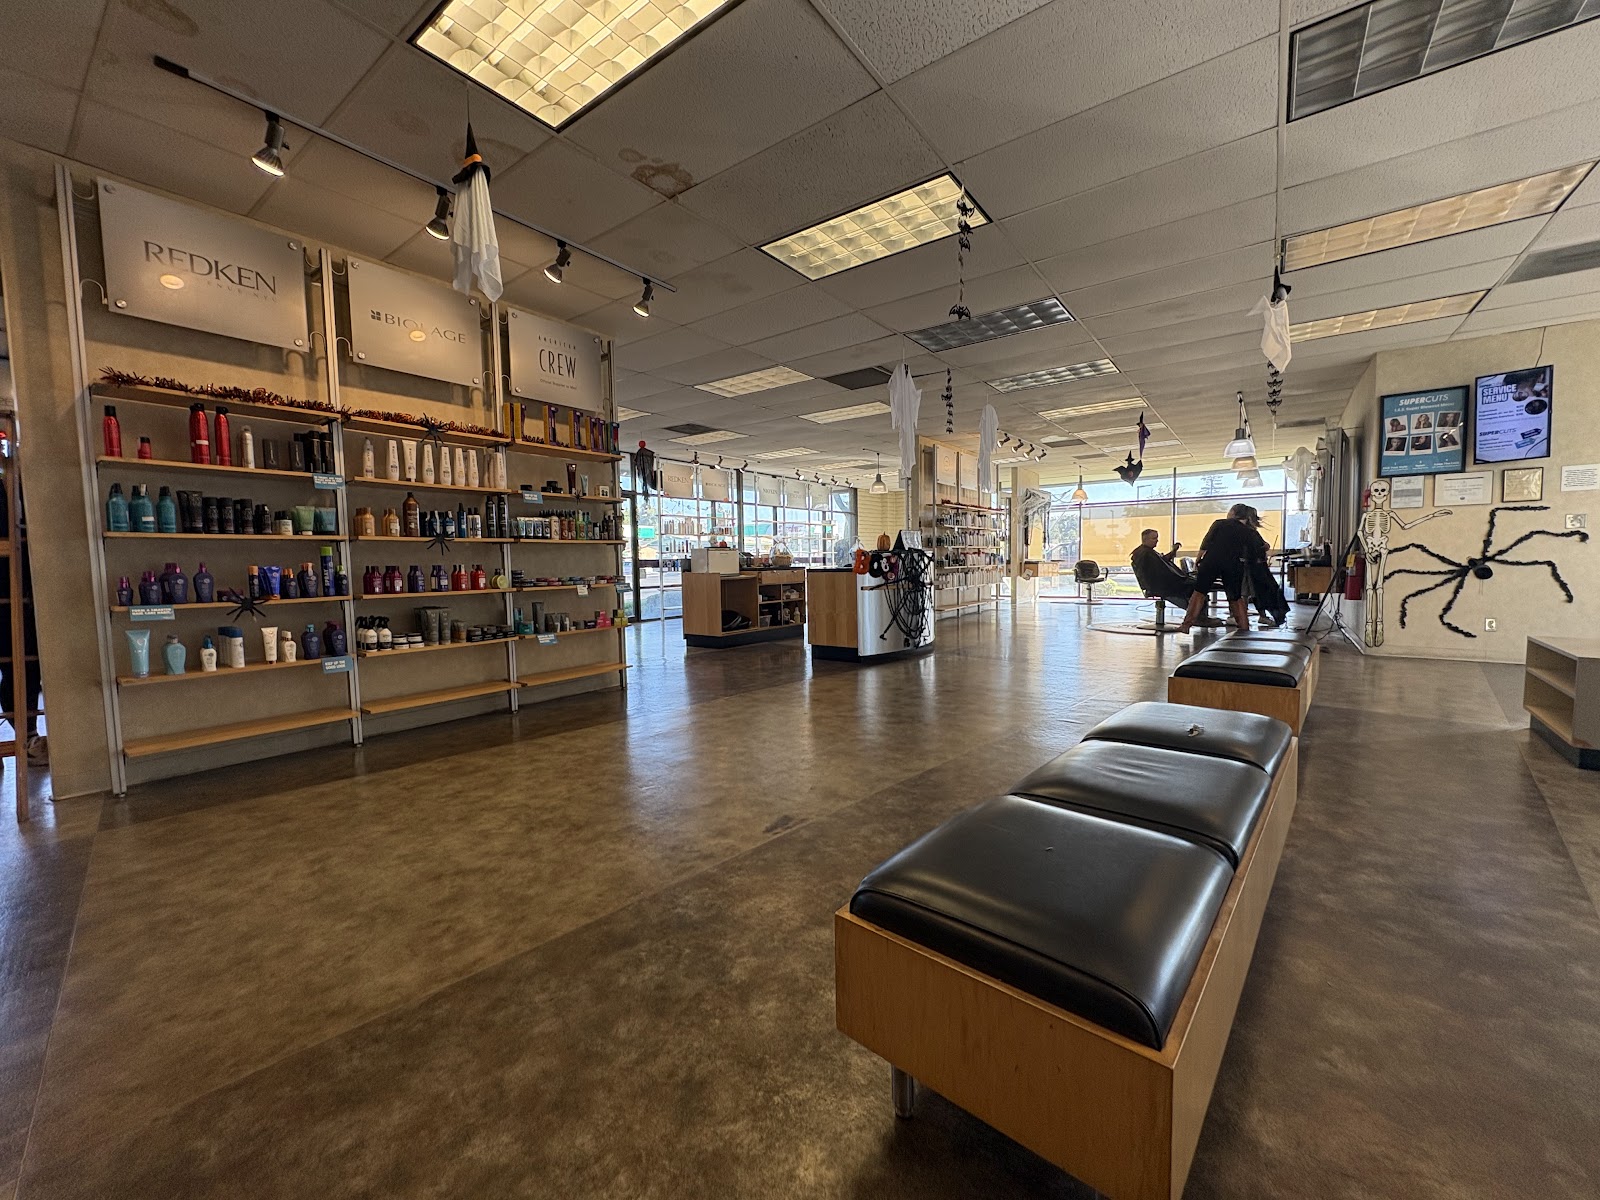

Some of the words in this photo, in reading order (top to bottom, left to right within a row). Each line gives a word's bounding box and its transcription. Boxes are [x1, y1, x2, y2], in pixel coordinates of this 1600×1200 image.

[143, 240, 277, 296] REDKEN
[539, 348, 577, 379] CREW
[1482, 383, 1517, 396] SERVICE
[1398, 393, 1449, 406] SUPERCUTS
[1482, 393, 1508, 405] MENU
[1479, 428, 1518, 437] SUPERCUTS
